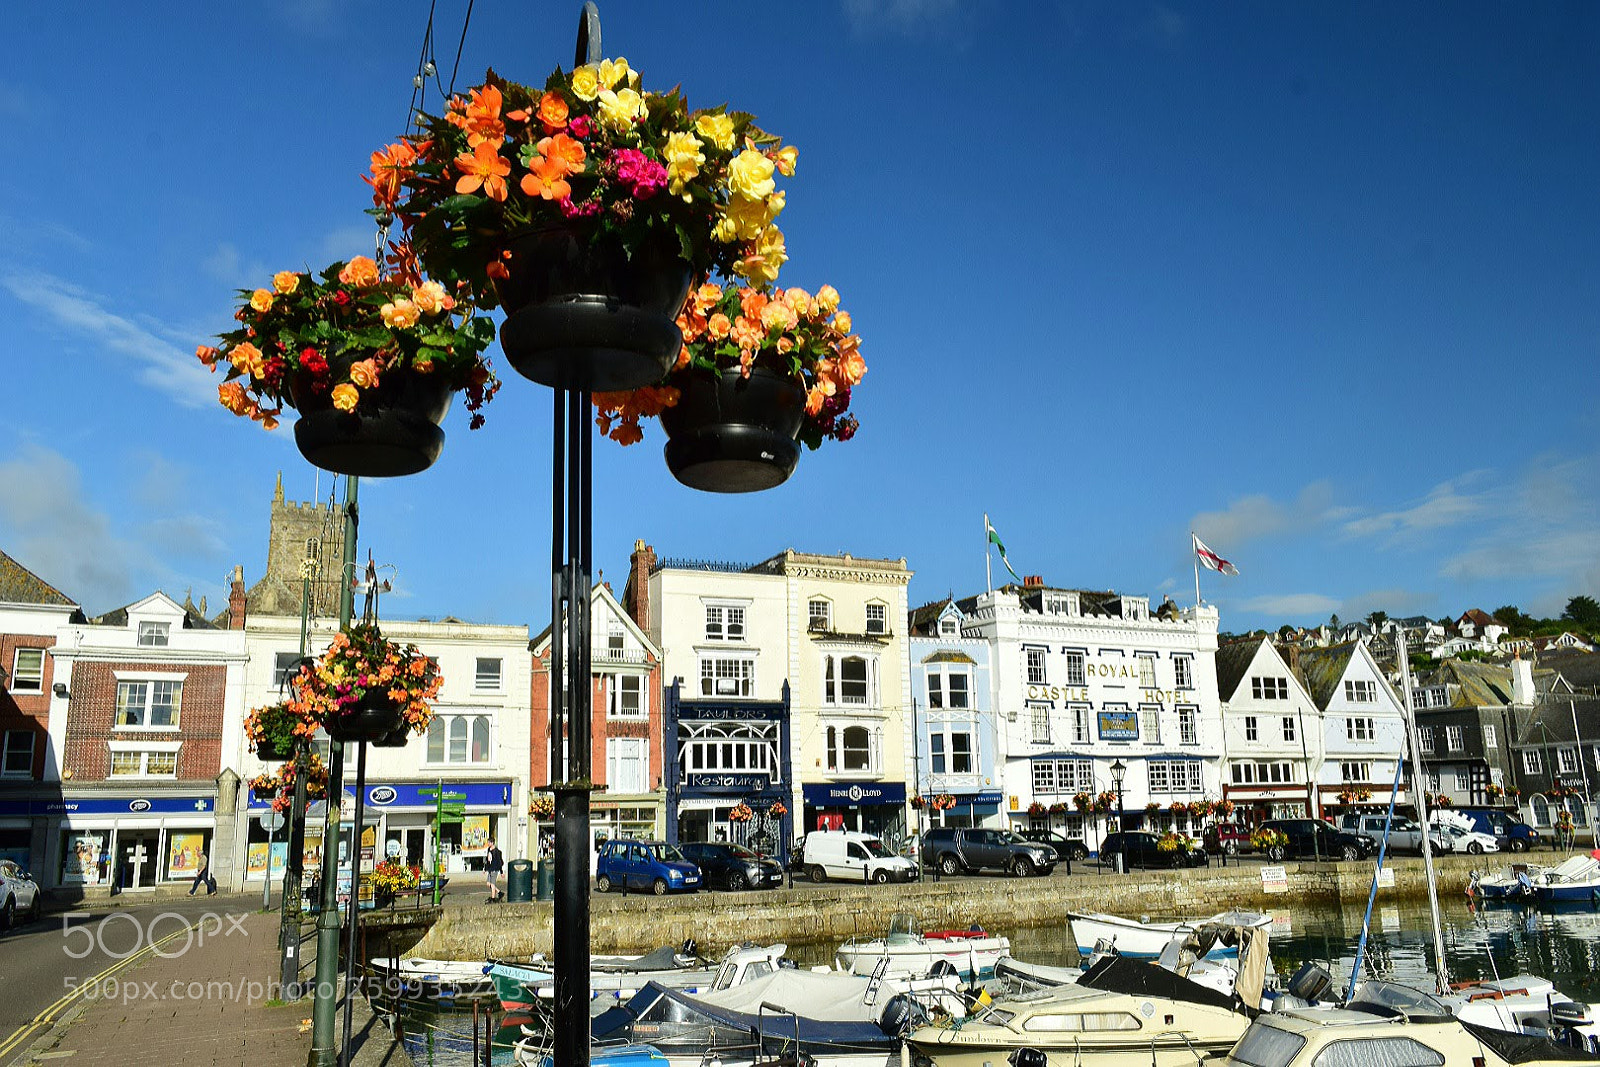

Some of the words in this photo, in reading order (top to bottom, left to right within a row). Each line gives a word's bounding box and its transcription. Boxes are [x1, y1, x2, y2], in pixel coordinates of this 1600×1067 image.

[1087, 663, 1138, 678] ROYAL
[1027, 685, 1089, 701] CASTLE
[1145, 689, 1191, 704] HOTEL
[697, 709, 767, 719] TAYLORS
[1560, 778, 1590, 787] NatWet
[830, 789, 849, 797] HENRI
[862, 789, 882, 797] LLOYD
[47, 803, 79, 811] pharmacy
